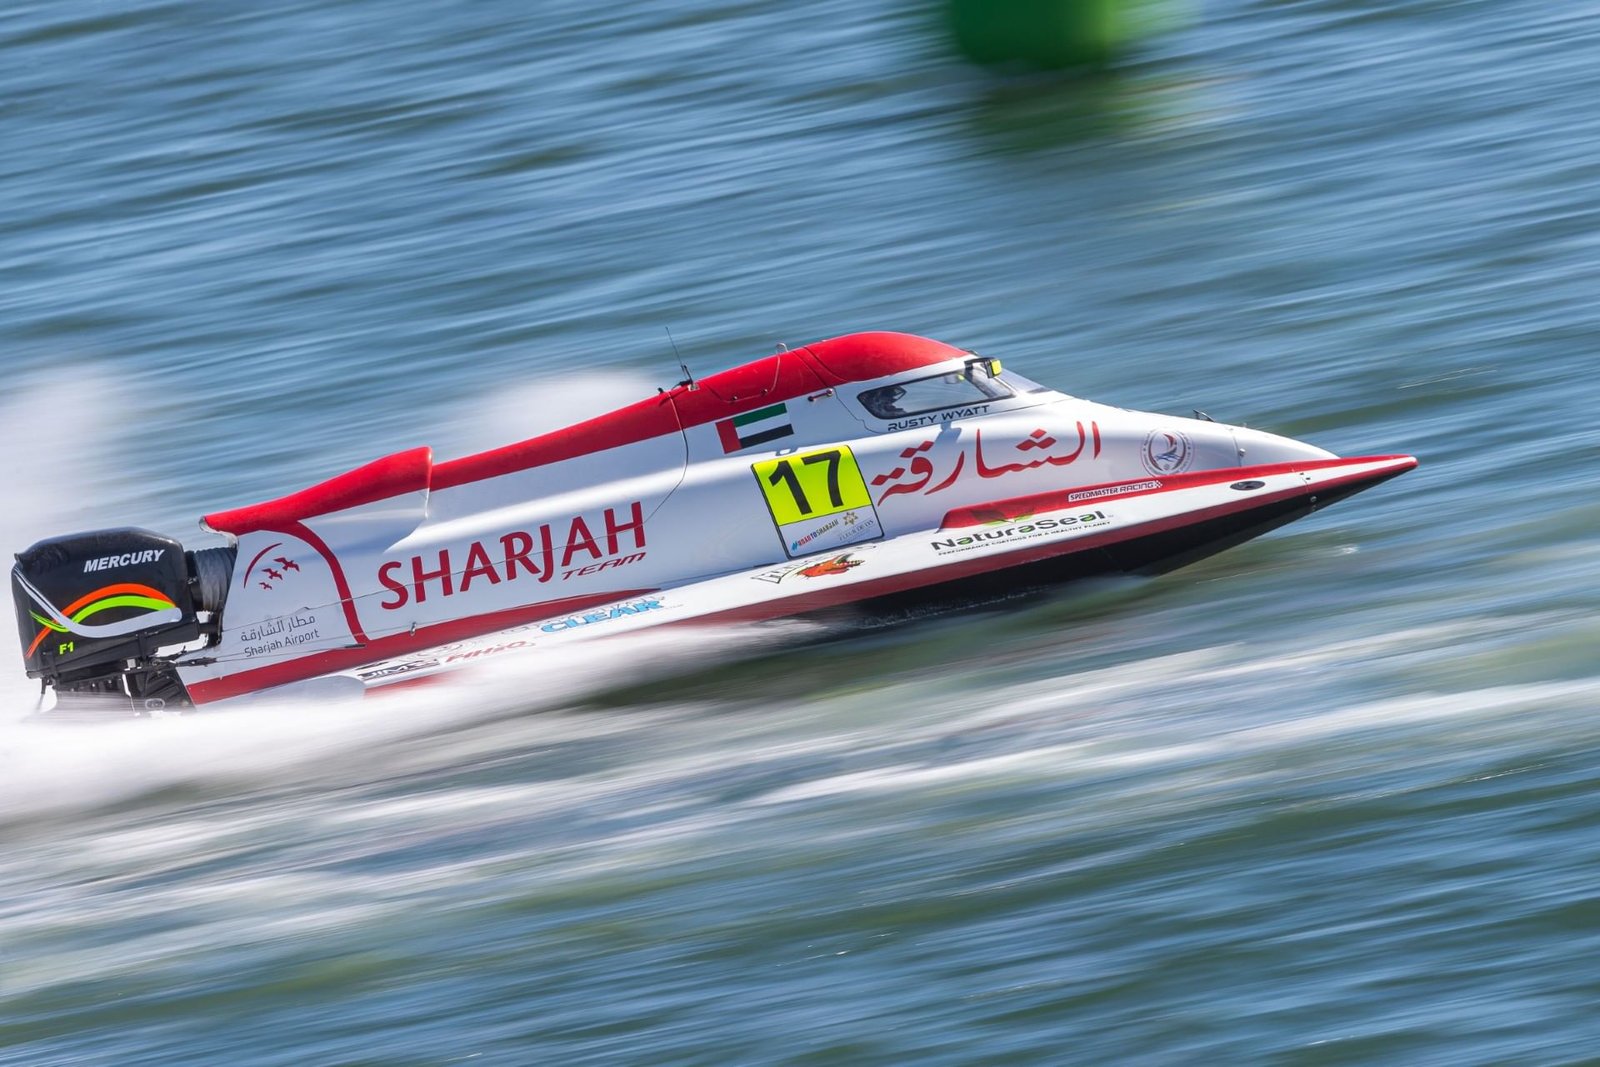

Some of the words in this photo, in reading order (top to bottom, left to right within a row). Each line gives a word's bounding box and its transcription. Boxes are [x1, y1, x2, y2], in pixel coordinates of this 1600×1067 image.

[887, 413, 937, 432] RUSTY
[941, 405, 990, 421] WYATT
[870, 421, 1101, 507] الشارقة
[768, 450, 844, 515] 17
[1070, 488, 1119, 501] SPEEDMASTER
[1119, 482, 1154, 493] RACING
[931, 510, 1105, 550] NaturaSeal
[938, 543, 990, 556] PERFORMANCE
[1050, 526, 1082, 535] HEALTHY
[1084, 521, 1111, 529] PLANET
[83, 549, 165, 573] MERCURY
[378, 501, 646, 610] SHARJAH
[561, 552, 647, 581] TEAM
[240, 619, 285, 642] الشارقة
[287, 615, 316, 632] مطار
[540, 600, 664, 633] CLEAR
[59, 641, 74, 655] F1
[244, 640, 283, 657] Sharjah
[284, 628, 320, 643] Airport
